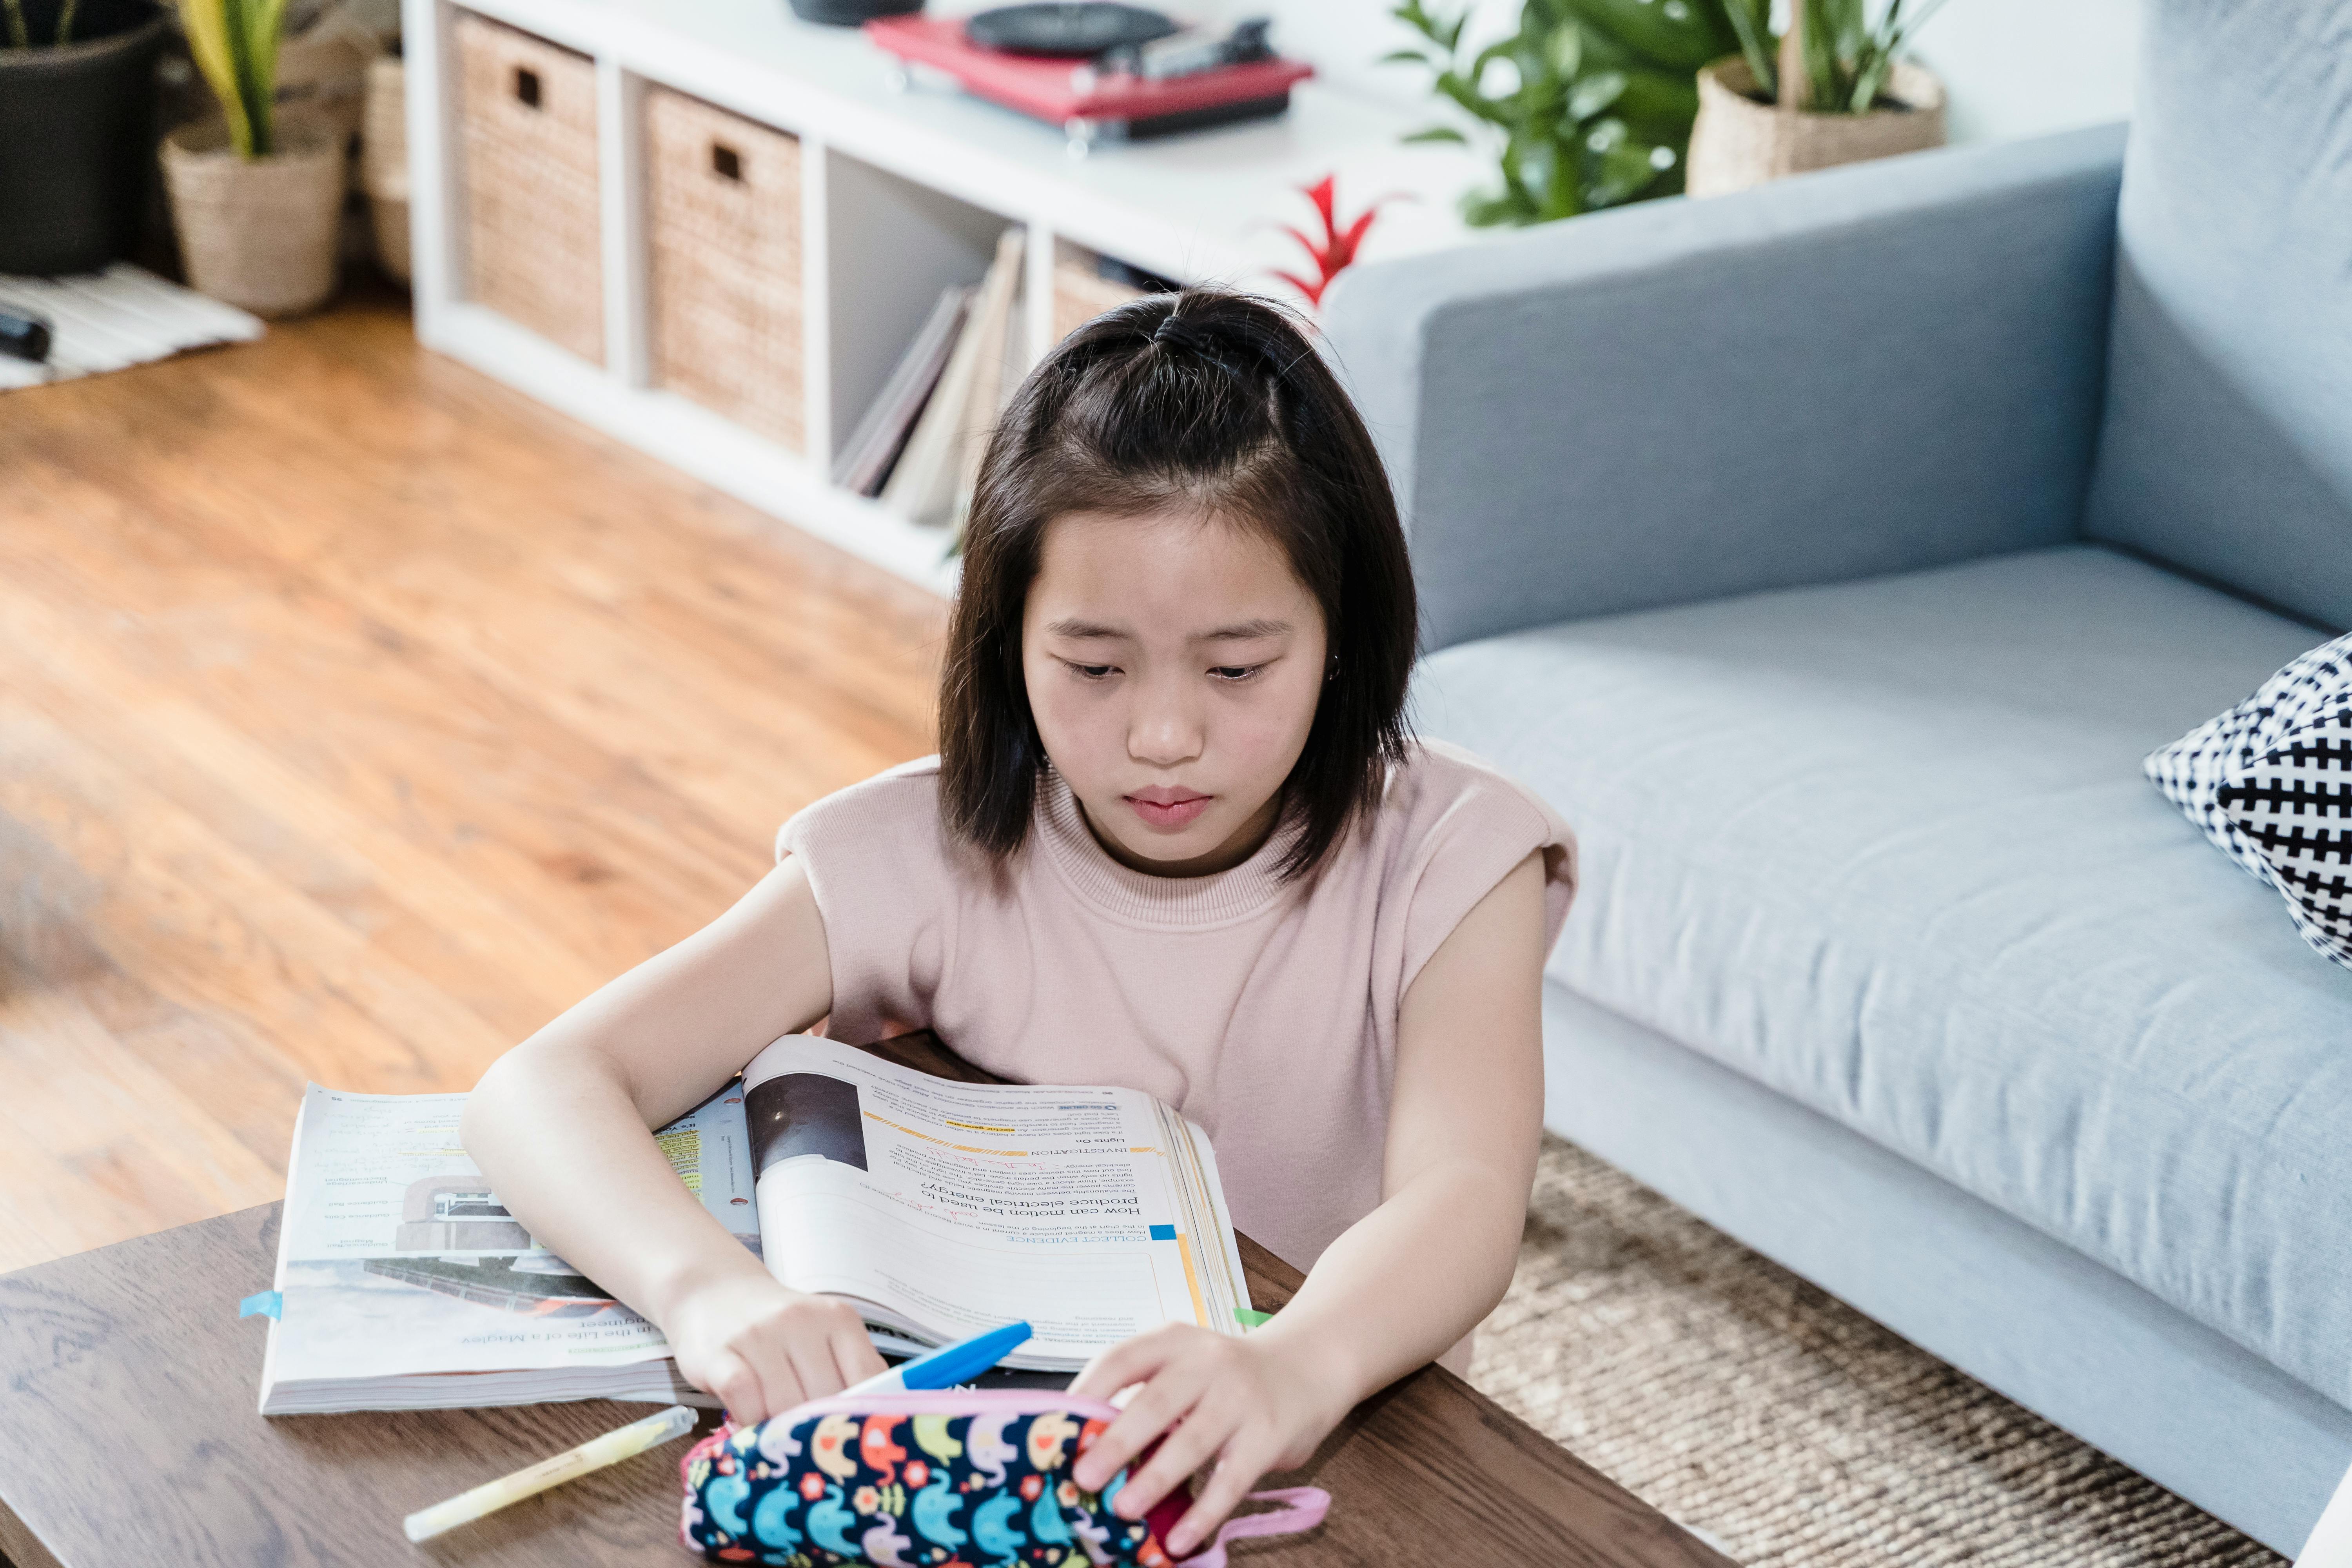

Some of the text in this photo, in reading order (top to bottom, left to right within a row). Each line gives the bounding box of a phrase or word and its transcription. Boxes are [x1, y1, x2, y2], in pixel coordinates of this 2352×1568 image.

[873, 1094, 888, 1103] uses
[891, 1102, 904, 1111] that
[905, 1112, 942, 1127] connected
[906, 1109, 929, 1120] device
[947, 1121, 984, 1129] generator
[889, 1150, 904, 1161] bike
[897, 1145, 926, 1158] produce
[890, 1155, 901, 1163] For
[905, 1152, 923, 1162] more
[894, 1162, 926, 1177] electrical
[926, 1160, 965, 1175] investigate
[938, 1160, 970, 1170] magnets
[920, 1167, 940, 1178] every
[931, 1166, 947, 1176] light
[944, 1180, 964, 1189] fields
[975, 1182, 1004, 1191] devices
[873, 1188, 904, 1205] evidence
[921, 1183, 984, 1203] energy?
[922, 1191, 935, 1200] to
[939, 1196, 978, 1210] used
[989, 1199, 1064, 1209] electrical
[1070, 1197, 1139, 1206] produce
[908, 1204, 922, 1212] your
[983, 1207, 1004, 1216] be
[926, 1211, 951, 1224] Record
[578, 1318, 647, 1328] ngineer
[460, 1334, 525, 1344] Maglev
[545, 1333, 562, 1341] of
[568, 1331, 598, 1340] Life
